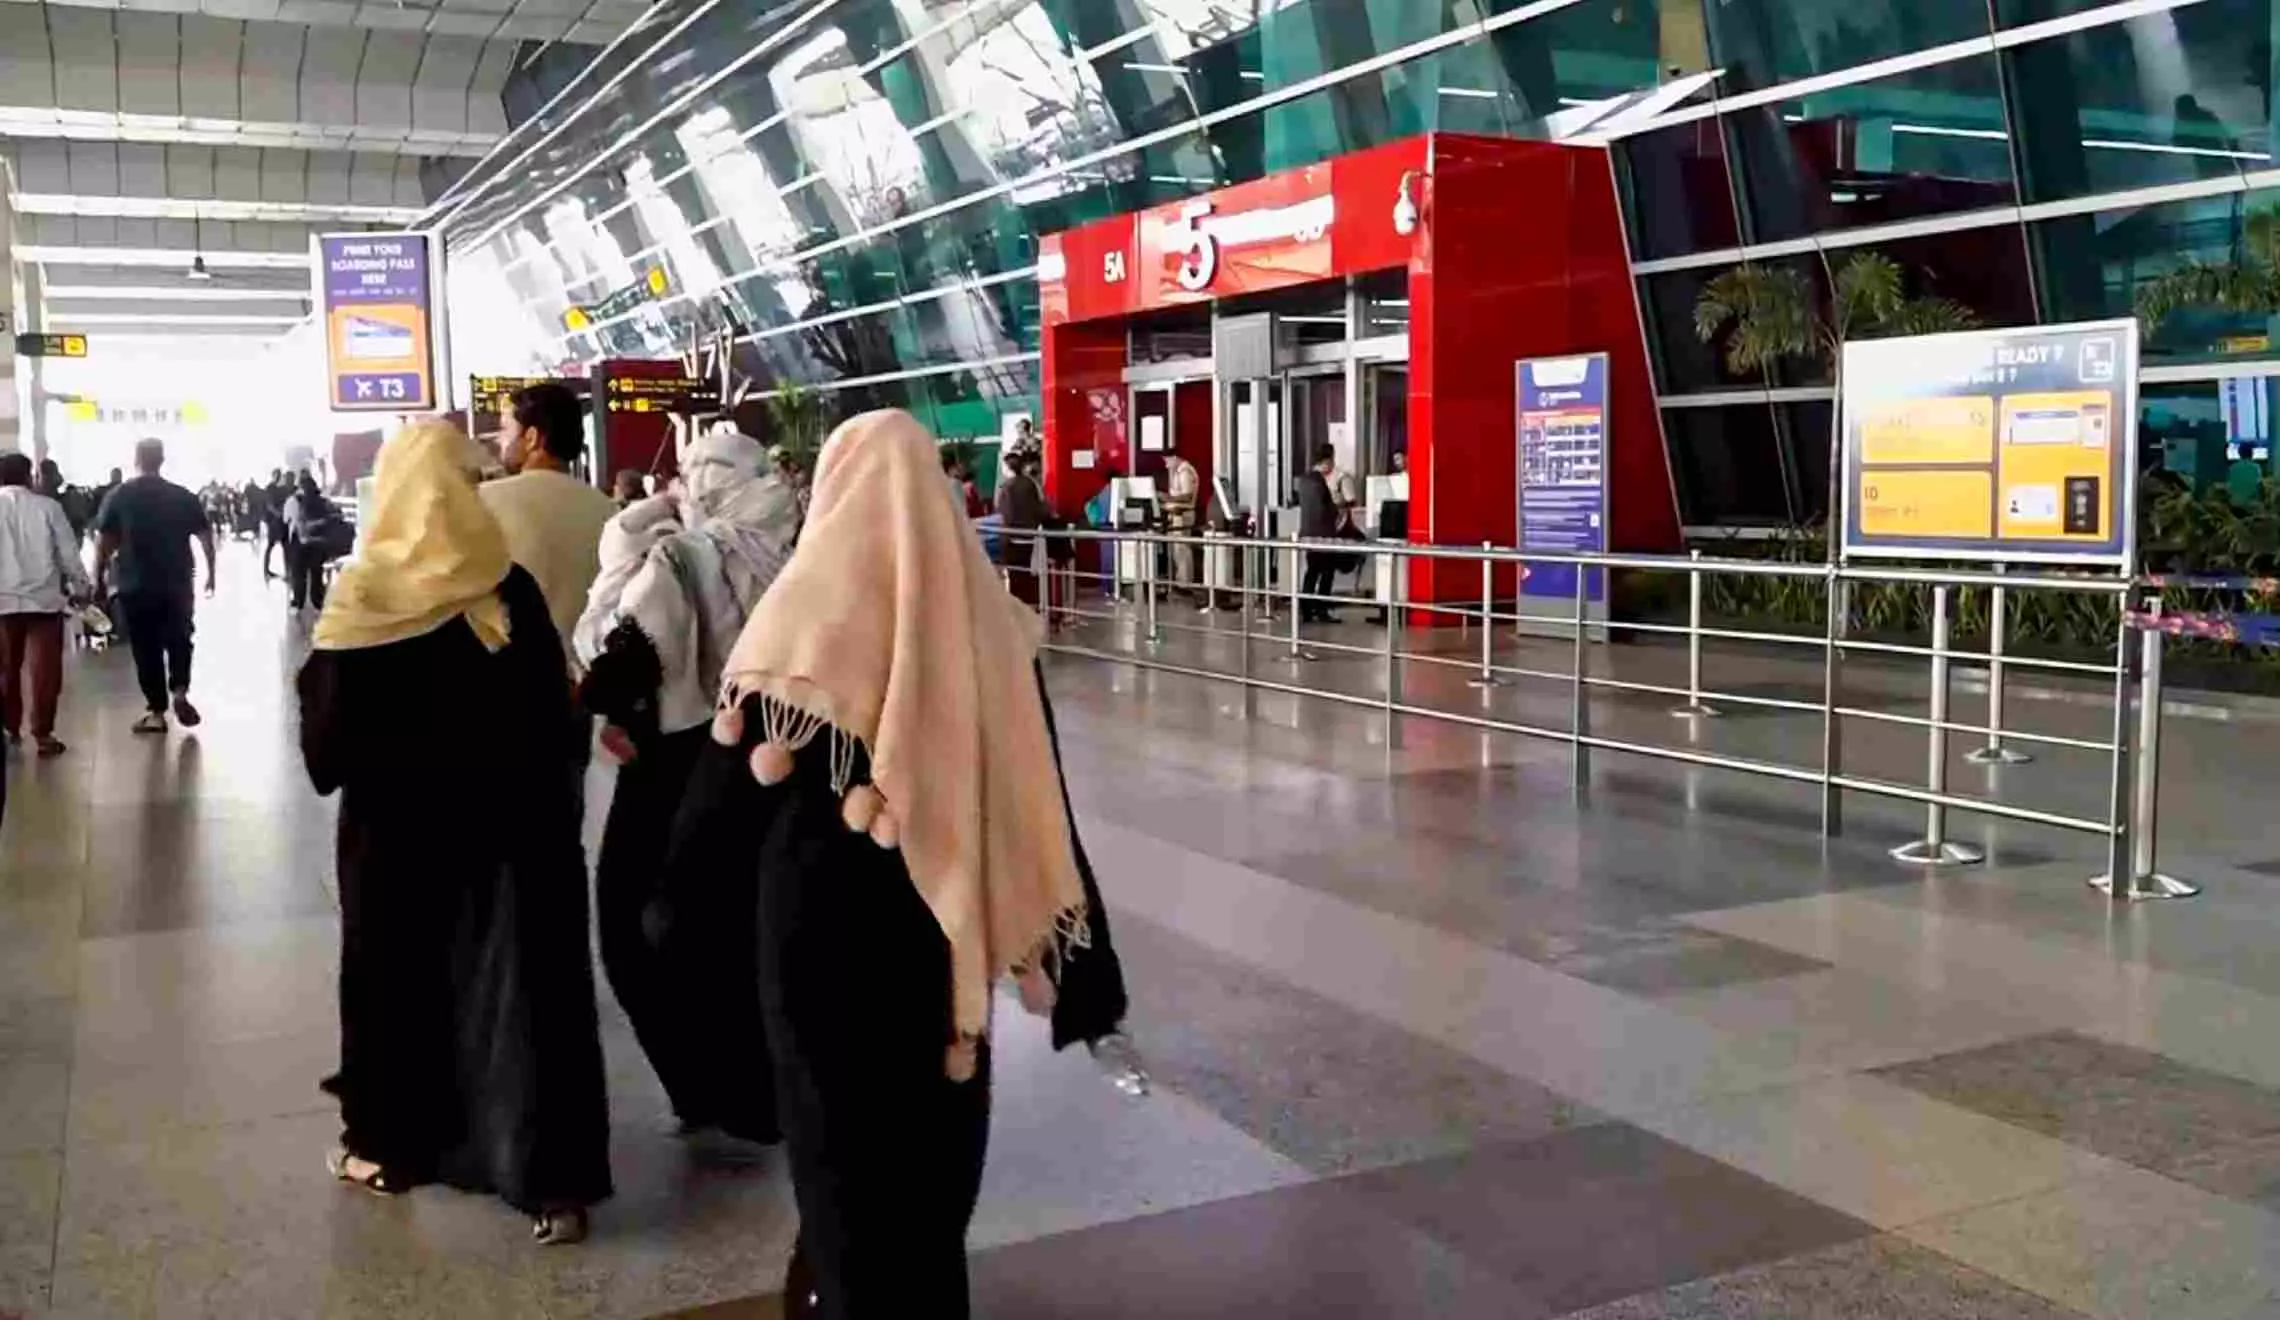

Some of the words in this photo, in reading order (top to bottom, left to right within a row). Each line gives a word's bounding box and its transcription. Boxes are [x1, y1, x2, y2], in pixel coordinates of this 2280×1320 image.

[1177, 199, 1218, 291] 5
[1103, 251, 1126, 282] 5A
[379, 378, 405, 398] T3
